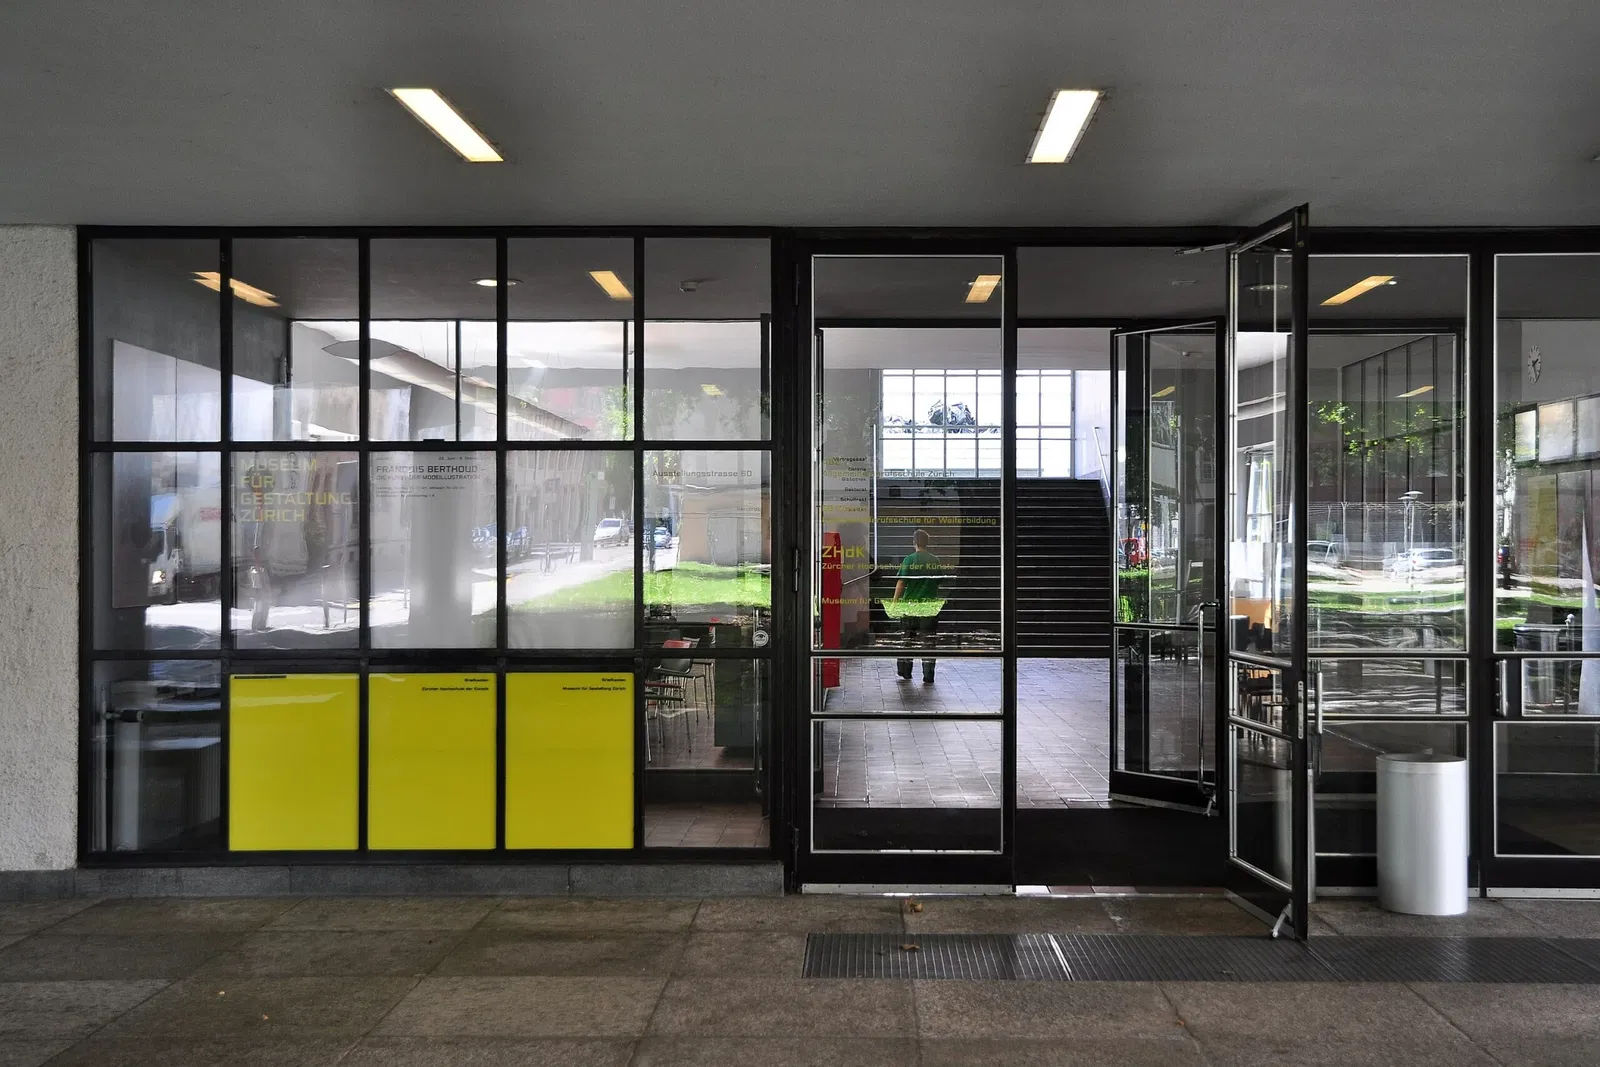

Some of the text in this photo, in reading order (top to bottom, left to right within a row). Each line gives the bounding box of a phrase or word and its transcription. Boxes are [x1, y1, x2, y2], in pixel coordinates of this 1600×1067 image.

[241, 458, 317, 472] MUSEUM
[427, 465, 478, 473] BERTHOUD
[652, 470, 753, 478] Ausstellungsstrasse 60
[241, 473, 275, 488] FÜR
[241, 491, 351, 505] GESTALTUNG
[241, 506, 305, 522] ZÜRICH
[939, 516, 997, 525] Weiterbildung
[821, 545, 865, 558] ZHdK
[822, 562, 854, 570] Zürcher
[909, 562, 924, 570] der
[822, 597, 856, 605] Museum
